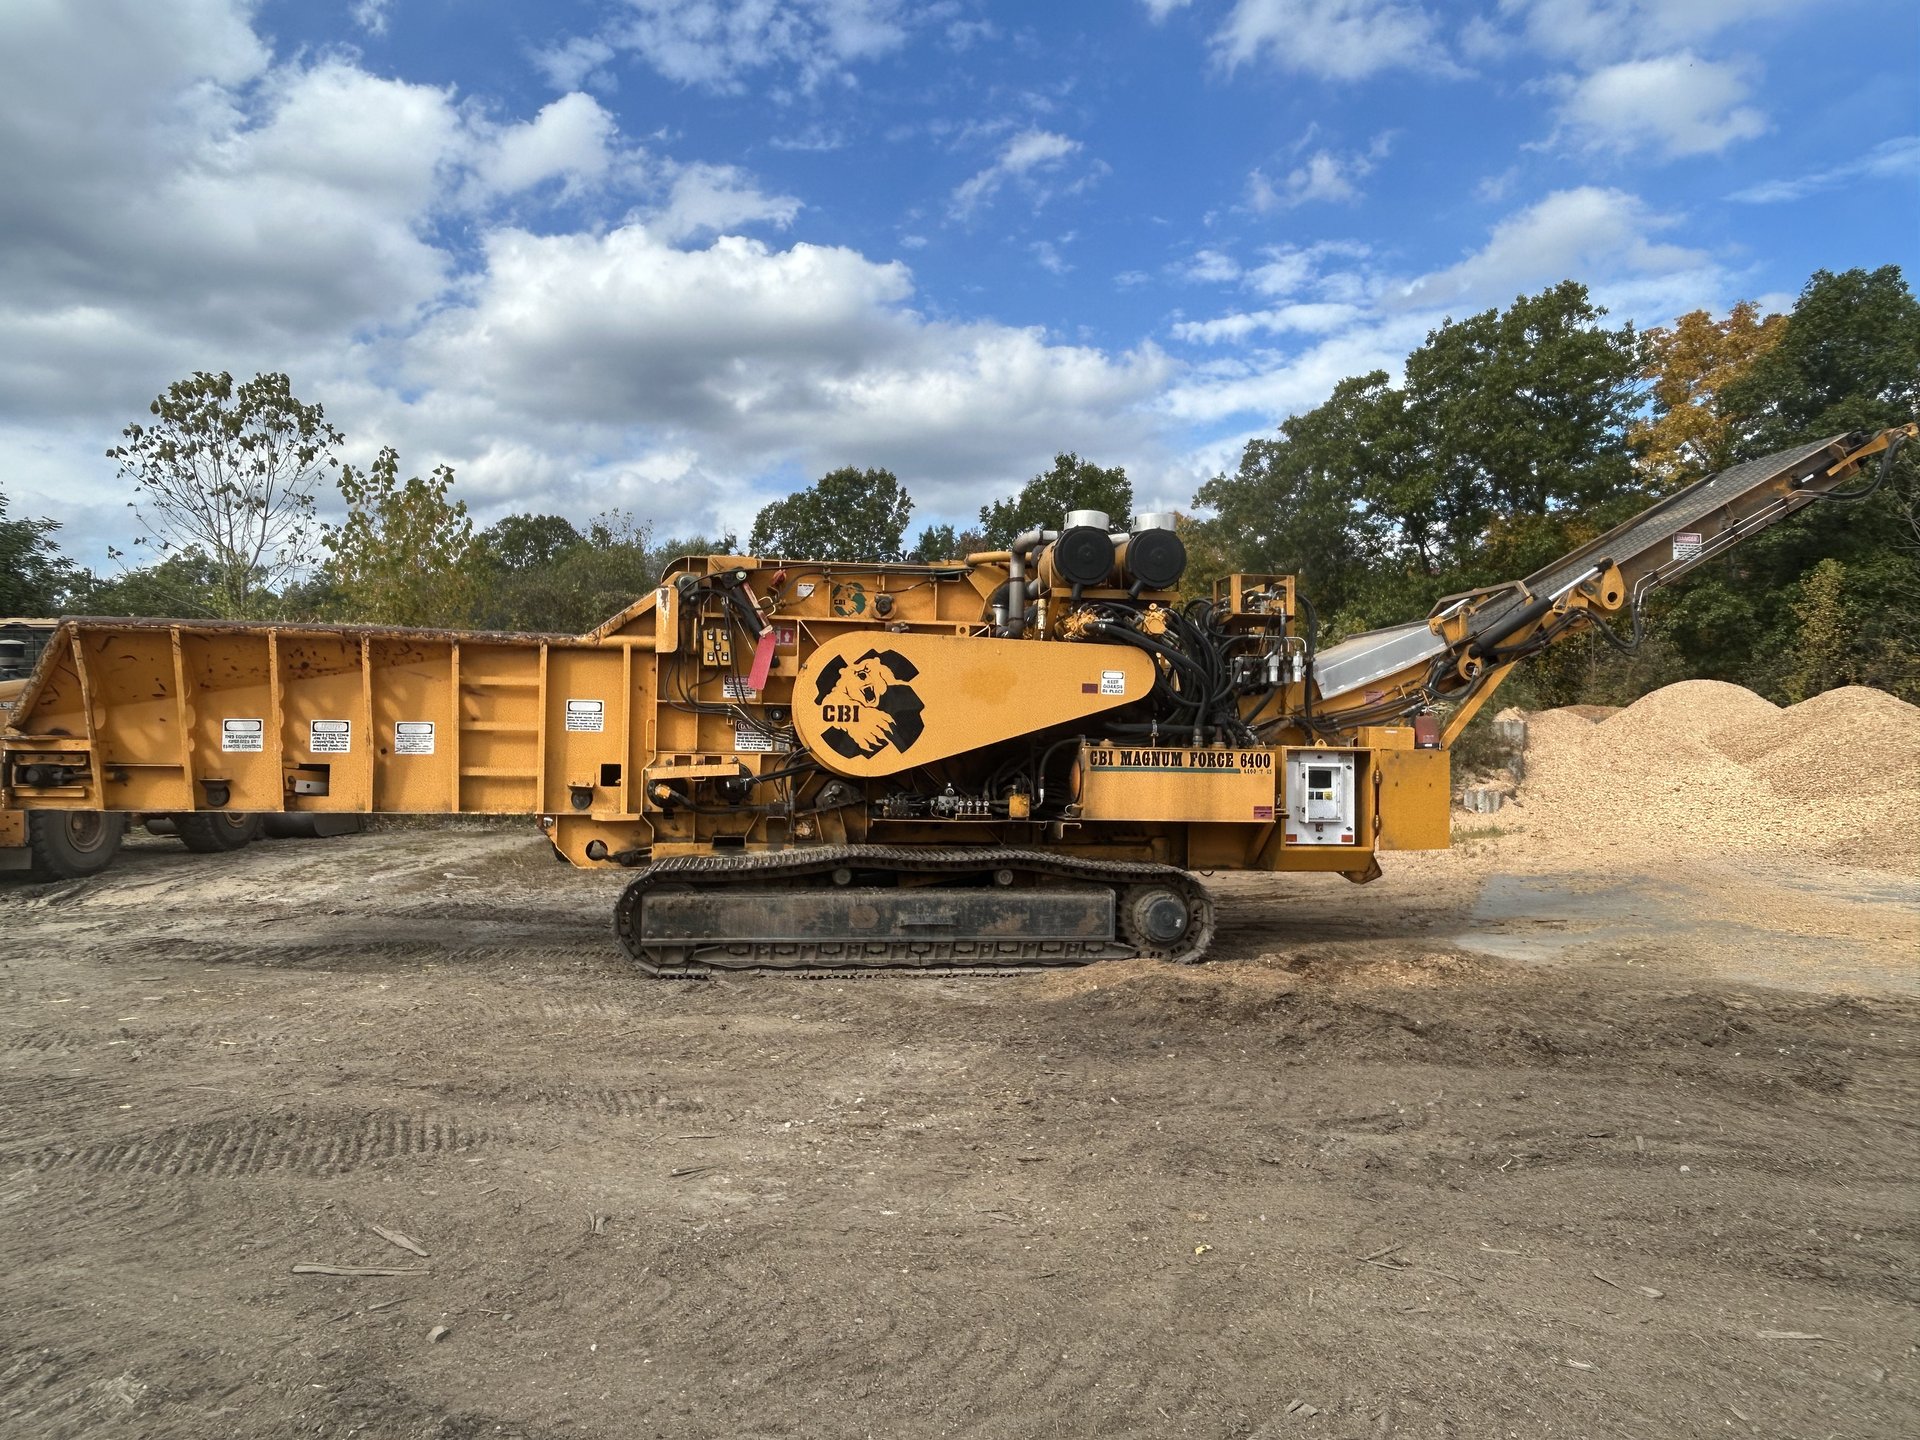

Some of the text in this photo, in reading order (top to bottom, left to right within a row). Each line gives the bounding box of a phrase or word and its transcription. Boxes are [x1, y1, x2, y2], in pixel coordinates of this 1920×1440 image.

[822, 704, 860, 722] CBI
[1089, 750, 1271, 768] CBI MAGNUM FORCE 6400
